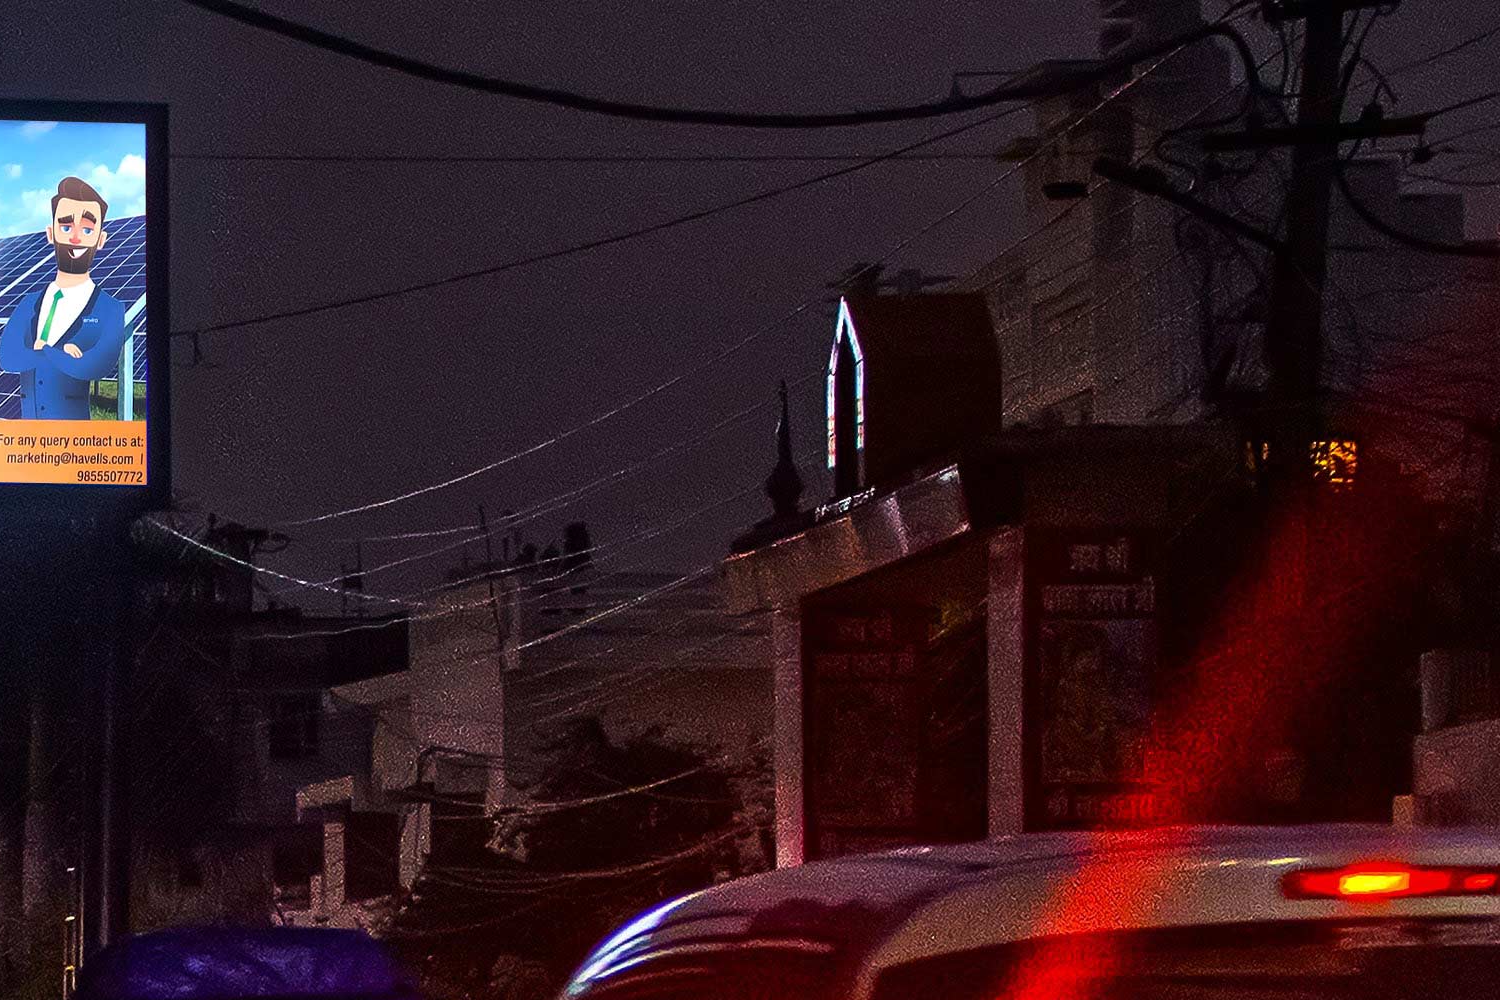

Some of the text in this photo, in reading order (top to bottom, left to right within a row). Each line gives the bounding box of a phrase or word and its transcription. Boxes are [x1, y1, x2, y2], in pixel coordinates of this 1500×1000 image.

[17, 436, 37, 449] any
[39, 436, 70, 449] query
[72, 434, 112, 448] contact
[115, 436, 128, 448] us
[130, 436, 145, 448] at:
[6, 451, 134, 467] marketing@havells.com
[77, 470, 143, 483] 9855507772
